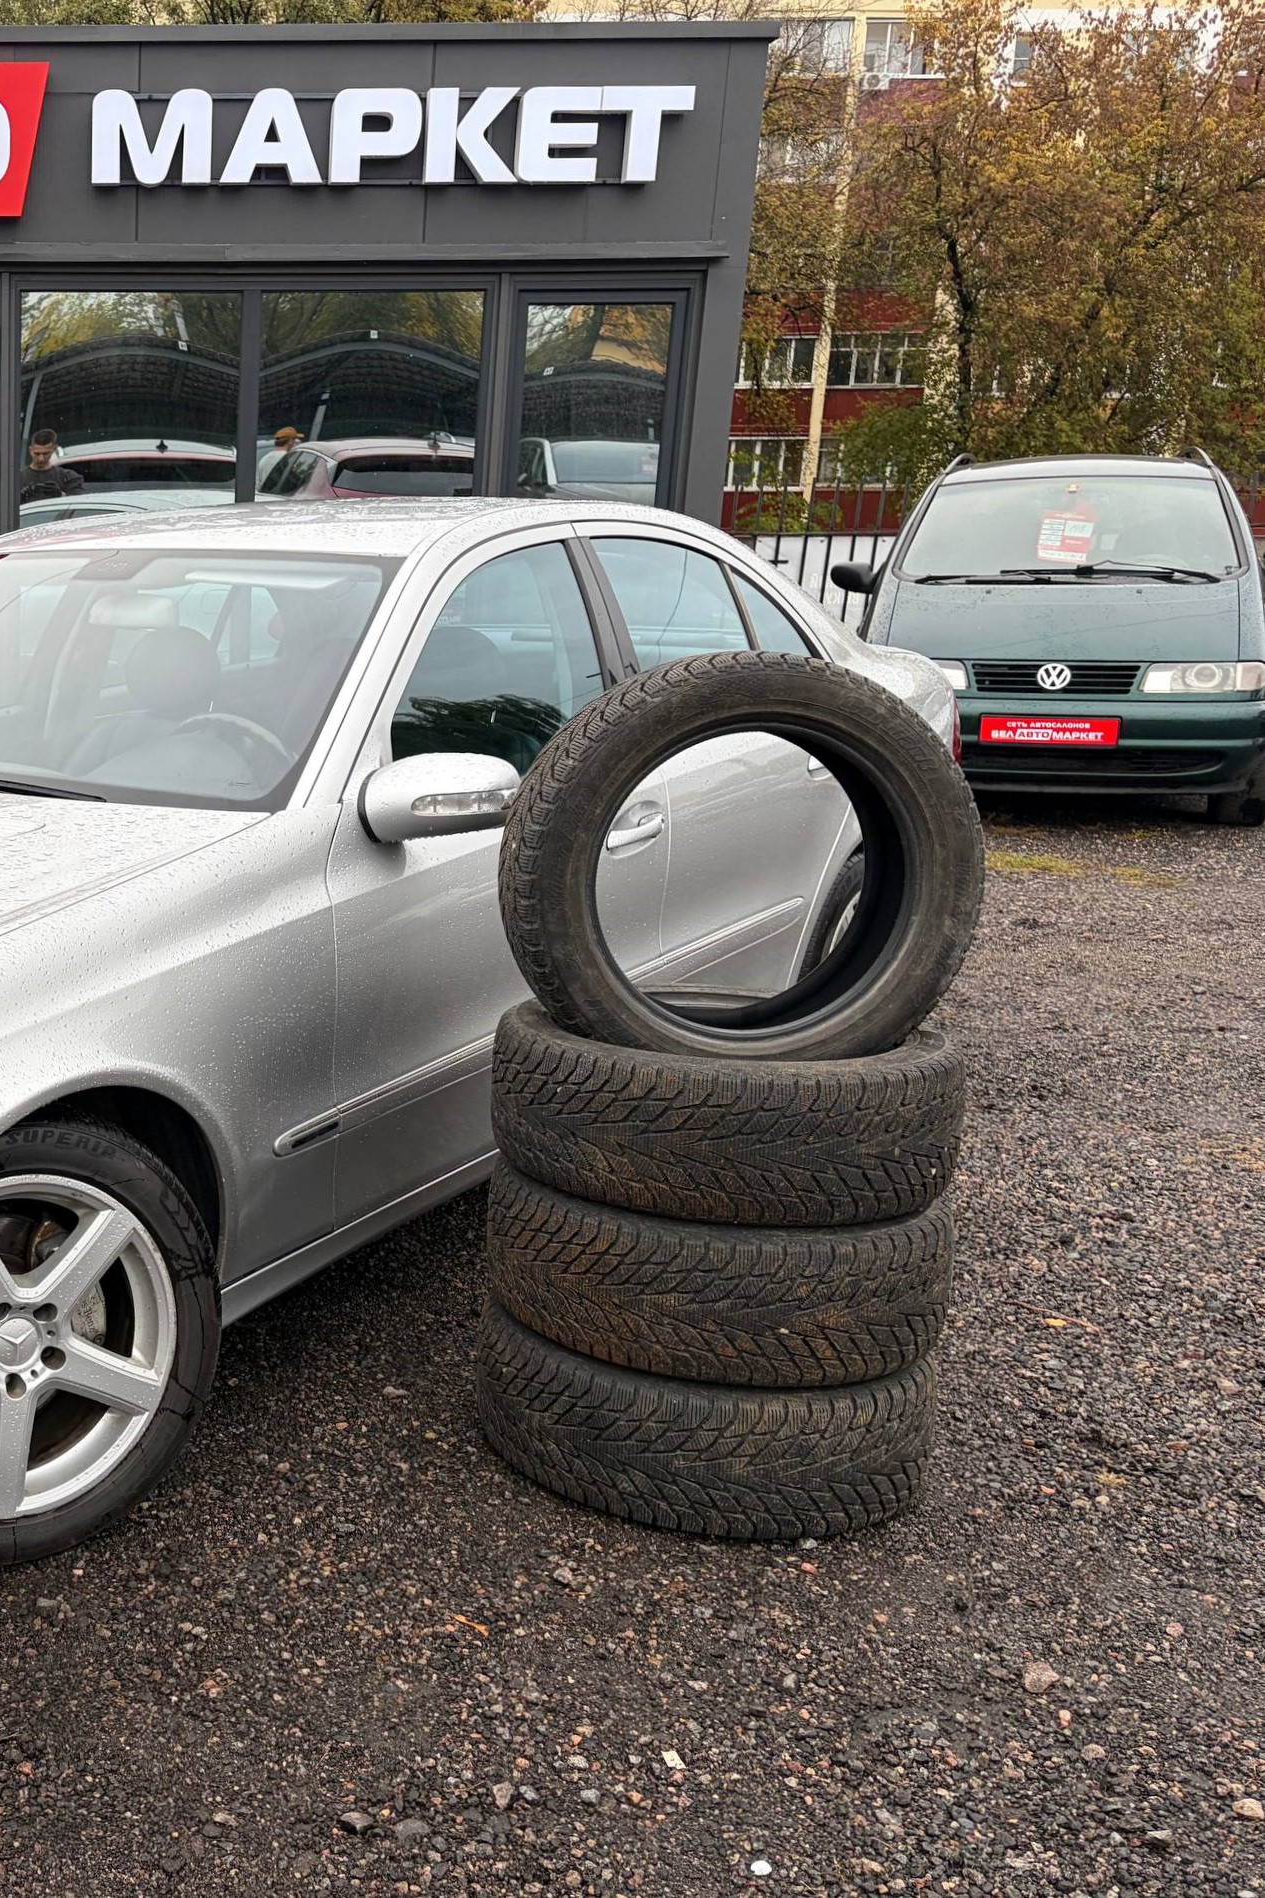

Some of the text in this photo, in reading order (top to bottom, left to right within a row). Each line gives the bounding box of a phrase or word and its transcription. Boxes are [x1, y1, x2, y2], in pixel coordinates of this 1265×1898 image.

[91, 85, 697, 186] МАРКЕТ
[991, 729, 1104, 740] БЕЛ АВТО МАРКЕТ
